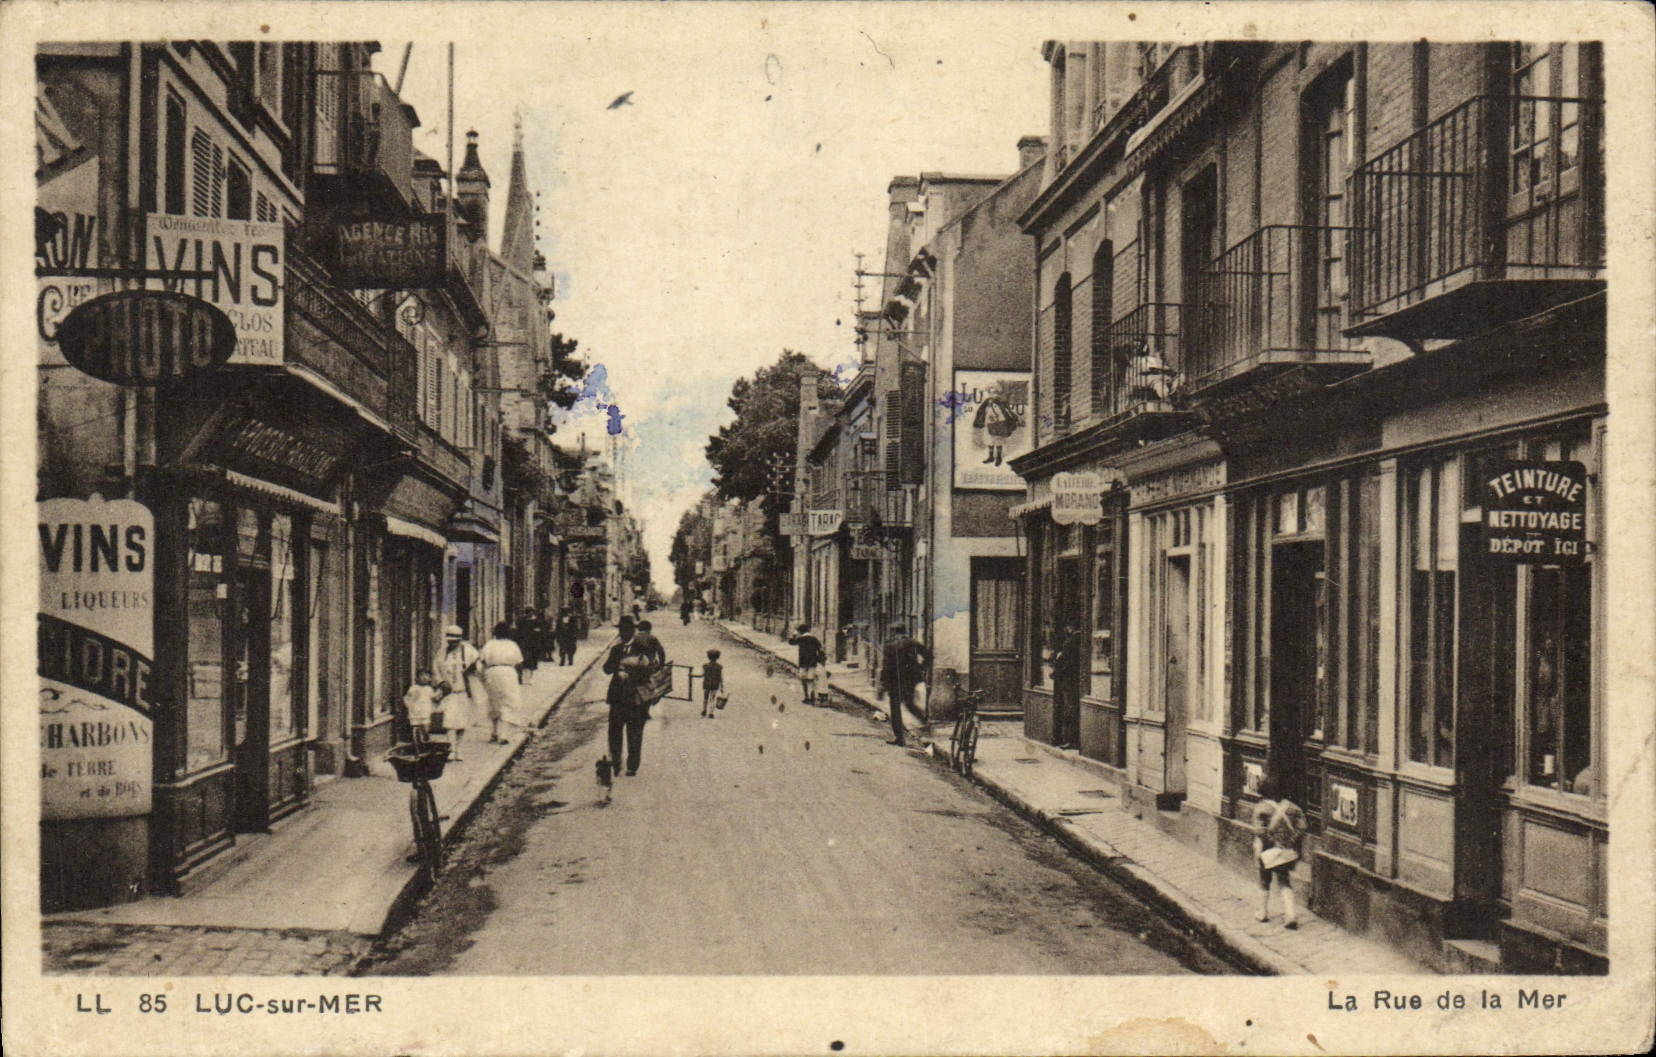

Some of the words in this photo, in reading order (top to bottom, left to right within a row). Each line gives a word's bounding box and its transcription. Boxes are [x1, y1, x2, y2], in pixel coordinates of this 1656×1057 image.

[153, 235, 279, 307] VINS
[1488, 468, 1583, 502] TEINTURE
[1523, 495, 1544, 505] ET
[1488, 510, 1582, 530] NETTOYAGE
[38, 523, 146, 573] VINS
[60, 590, 149, 611] LIQUEURS
